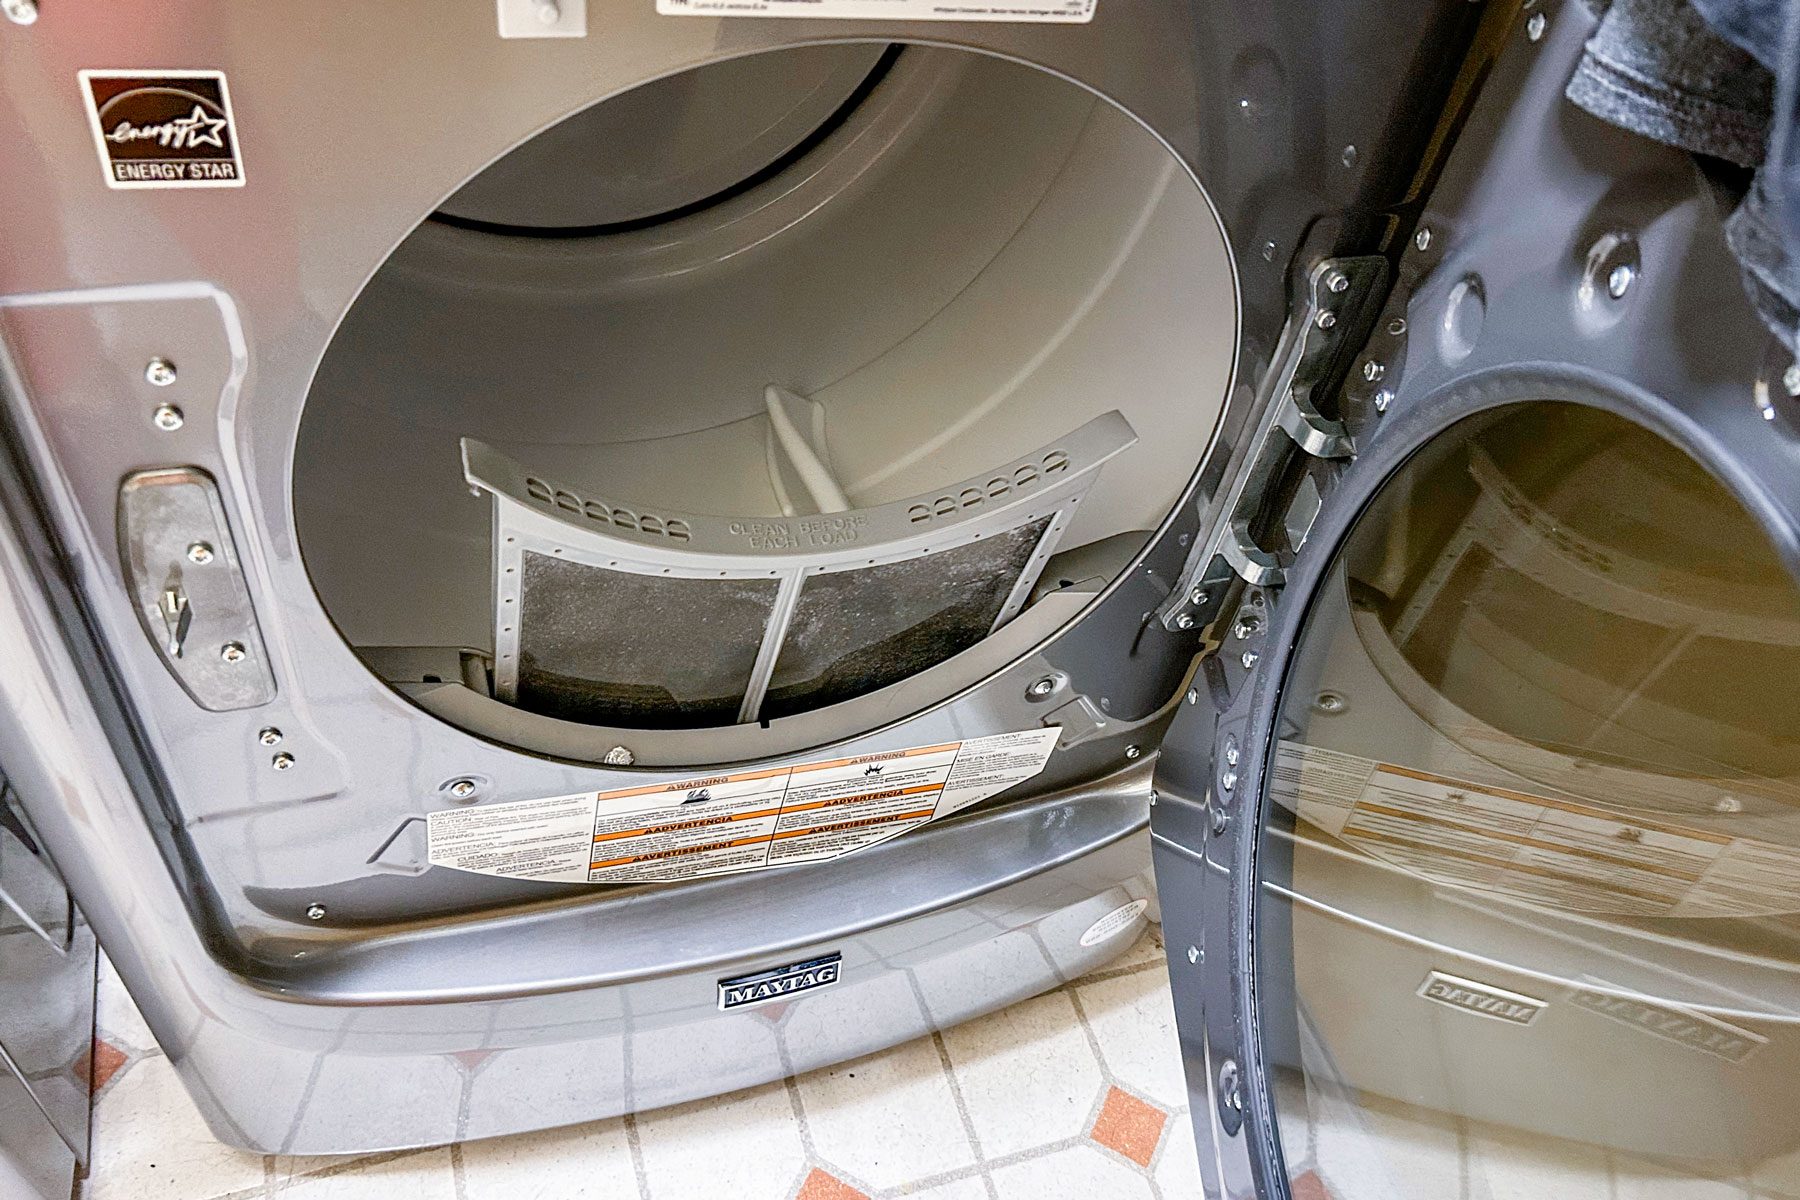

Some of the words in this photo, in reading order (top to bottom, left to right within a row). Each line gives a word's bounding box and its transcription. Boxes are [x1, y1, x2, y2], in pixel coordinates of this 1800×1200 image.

[116, 164, 188, 180] ENERGY
[190, 163, 234, 179] STAR
[729, 521, 789, 536] CLEAN
[800, 516, 867, 534] BEFORE
[749, 536, 798, 550] EACH
[810, 530, 858, 547] LOAD
[859, 751, 906, 764] WARNING
[674, 777, 728, 790] WARNING
[832, 790, 904, 806] ADVERTENCIA
[654, 816, 734, 833] ADVERTENCIA
[817, 815, 900, 833] AVERTISSEMENT
[642, 841, 734, 861] AVERTISSEMENT
[728, 968, 834, 1004] MAYTAG
